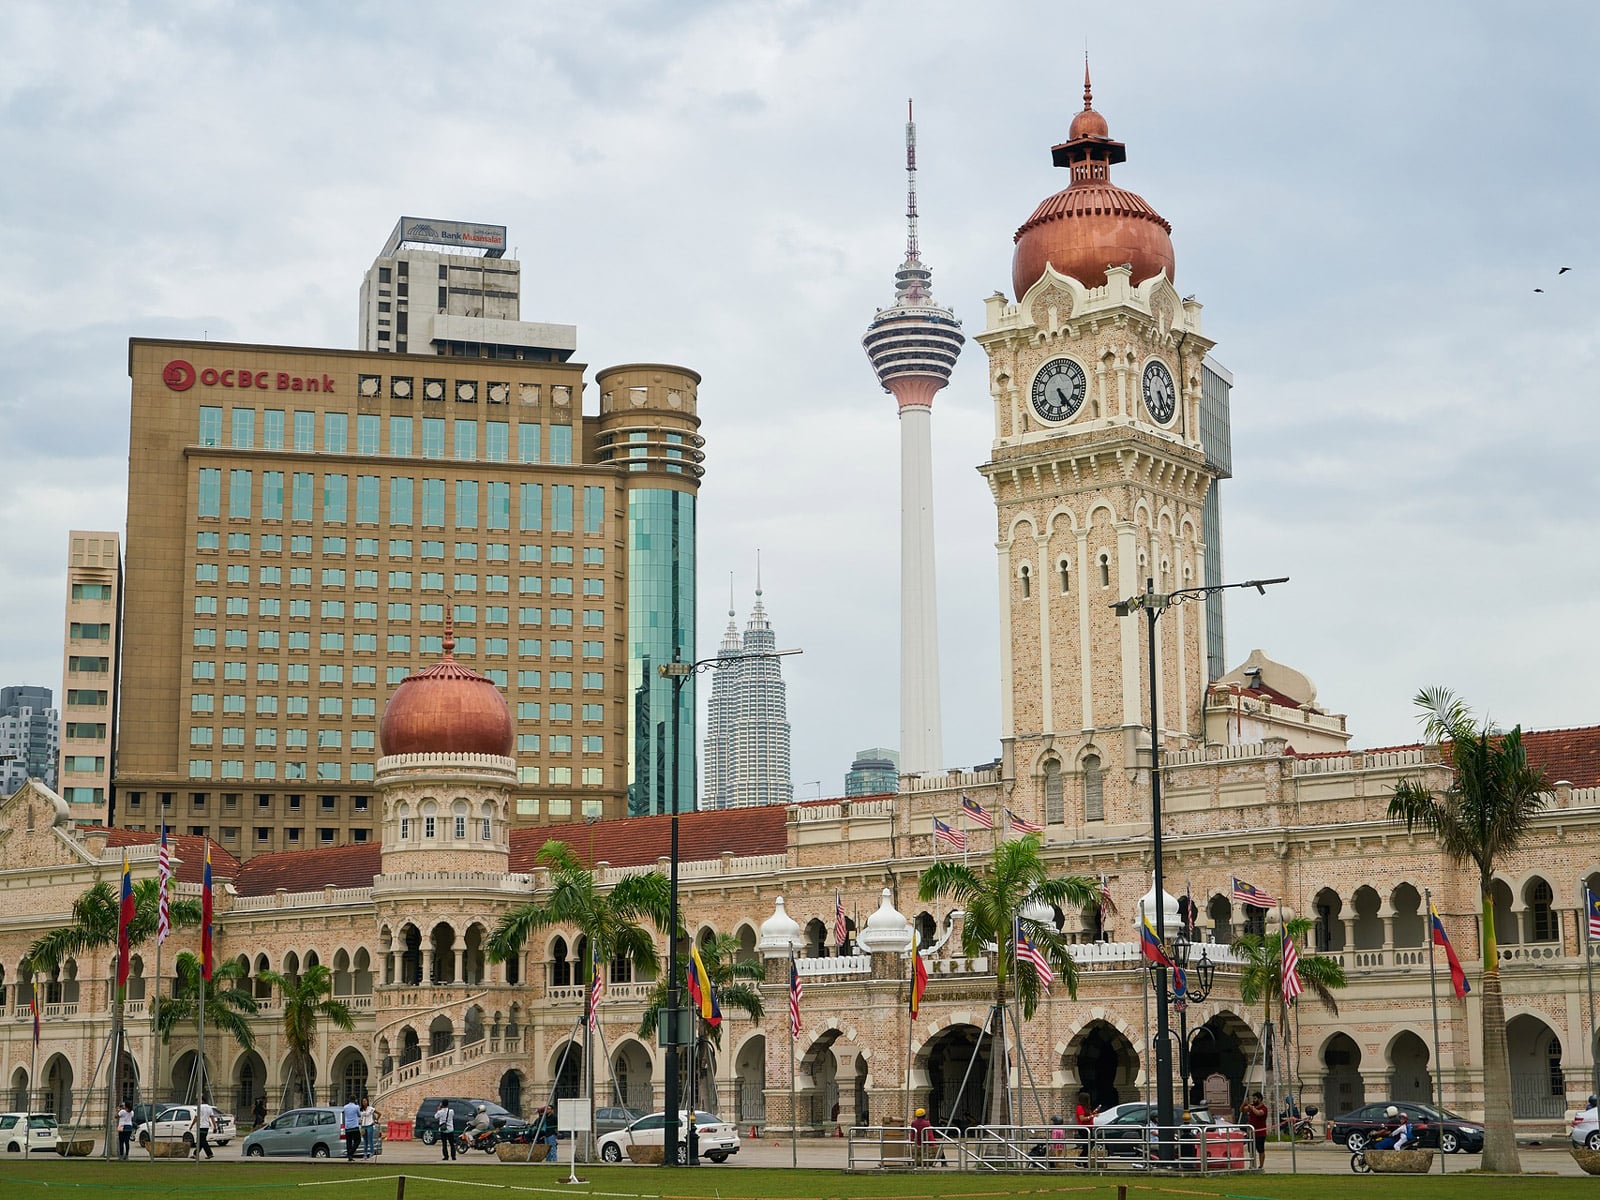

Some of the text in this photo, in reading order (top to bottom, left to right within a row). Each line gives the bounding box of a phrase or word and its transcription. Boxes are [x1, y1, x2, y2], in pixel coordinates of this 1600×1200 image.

[441, 230, 461, 240] Bank
[462, 232, 502, 244] Muamalat
[200, 368, 335, 393] OCBC Bank
